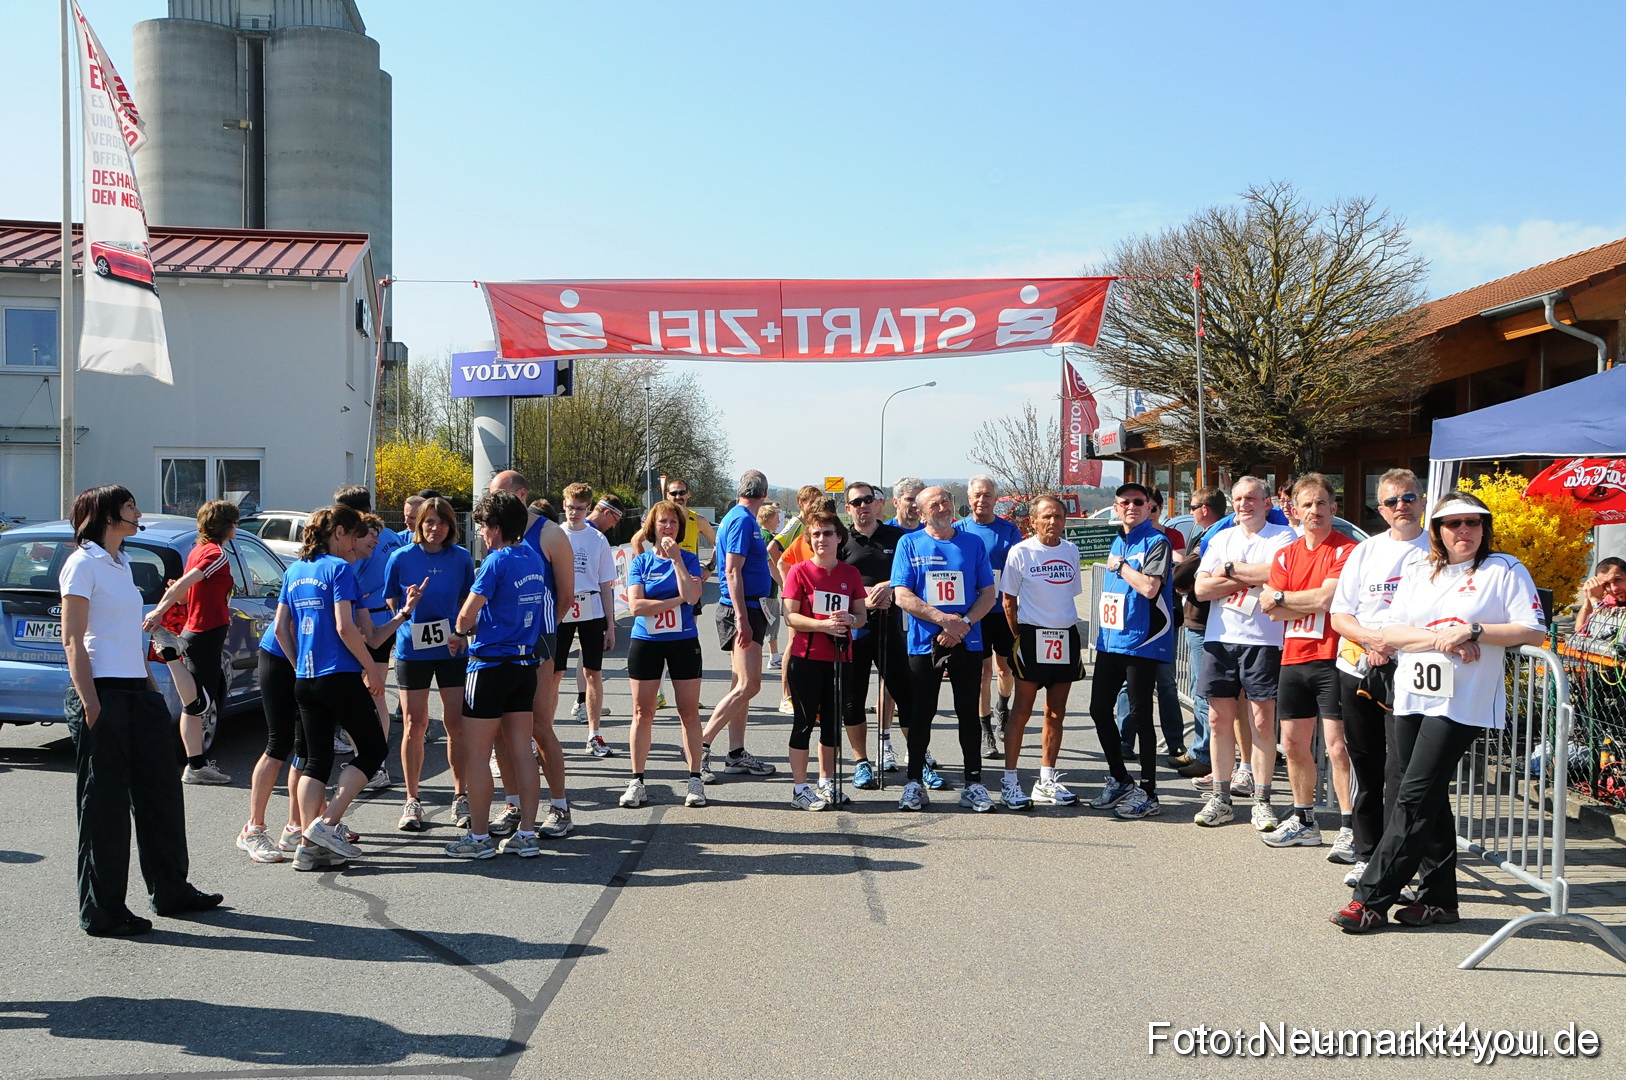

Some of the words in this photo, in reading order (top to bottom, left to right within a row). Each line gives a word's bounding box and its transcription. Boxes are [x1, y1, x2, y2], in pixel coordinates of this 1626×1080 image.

[91, 112, 113, 130] UND
[92, 150, 123, 168] OFFEN
[91, 188, 117, 206] DEN
[460, 362, 541, 382] VOLVO
[1101, 432, 1117, 446] SEAT
[1069, 450, 1079, 473] KIA
[1029, 564, 1068, 573] GERHART
[936, 581, 955, 602] 16
[824, 593, 842, 612] 18
[653, 609, 677, 630] 20
[1103, 604, 1117, 625] 83
[25, 622, 46, 637] NM
[421, 622, 445, 645] 45
[1044, 639, 1063, 660] 73
[1412, 661, 1442, 692] 30
